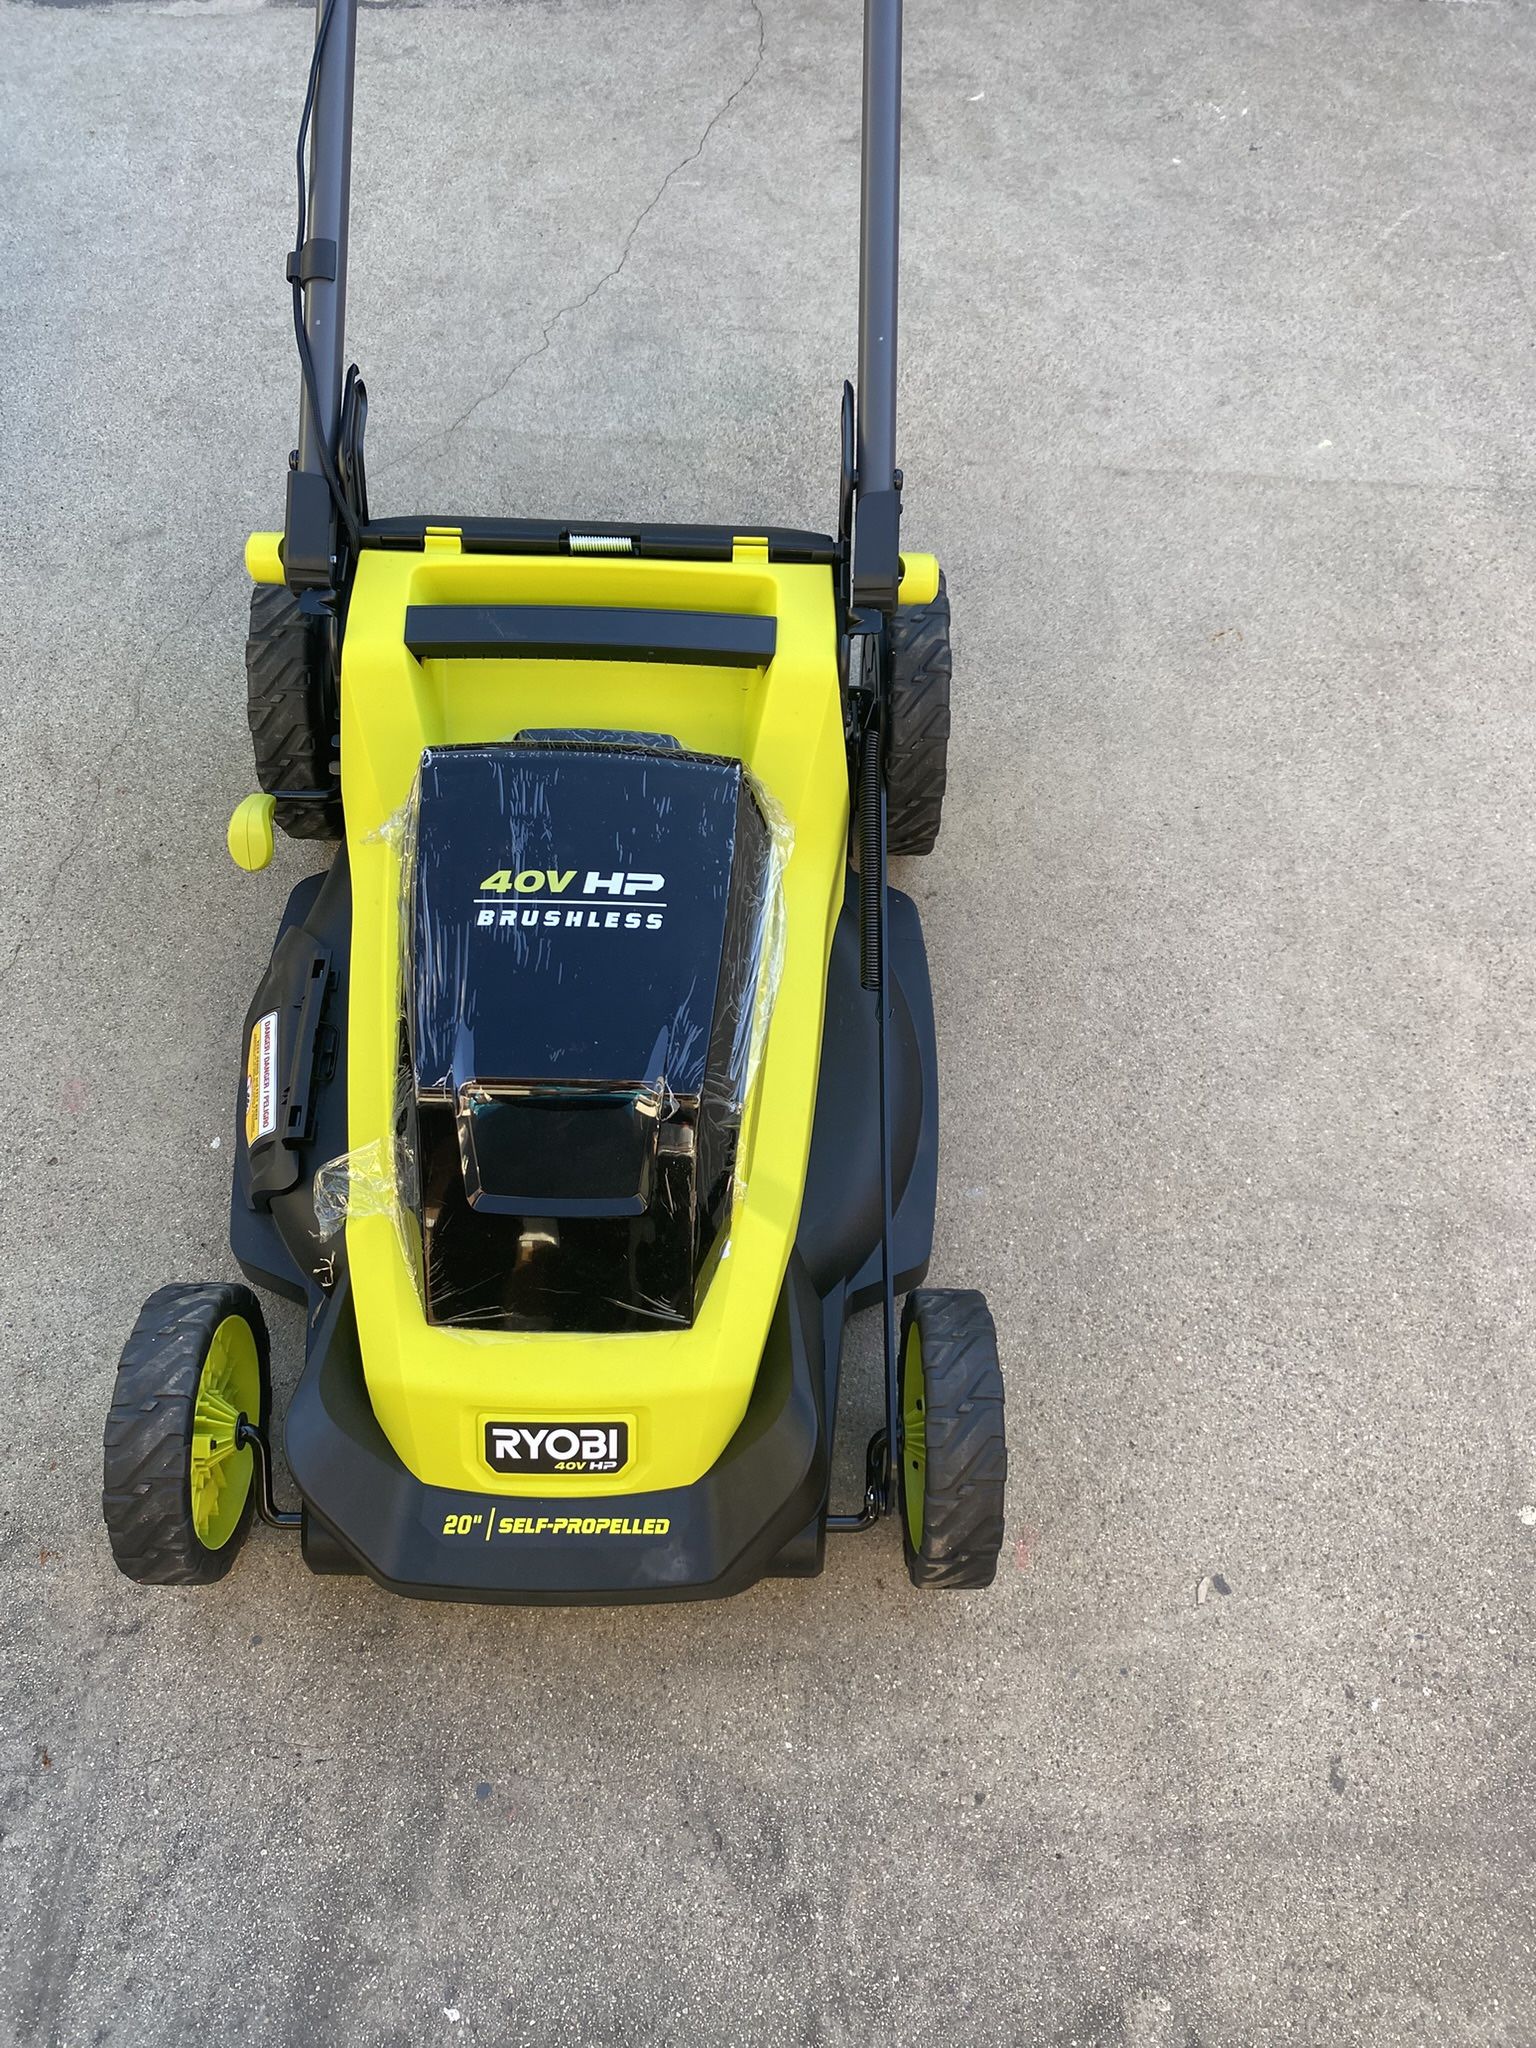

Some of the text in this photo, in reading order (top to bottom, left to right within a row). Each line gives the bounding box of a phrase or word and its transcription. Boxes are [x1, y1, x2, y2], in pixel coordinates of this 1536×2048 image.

[479, 870, 666, 896] 40V HP
[476, 909, 664, 930] BRUSHLESS
[262, 1095, 270, 1128] PELIGRO
[492, 1428, 618, 1461] RYOBI
[554, 1461, 618, 1470] 40V HP
[442, 1514, 671, 1535] 20" SELF-PROPELLED
